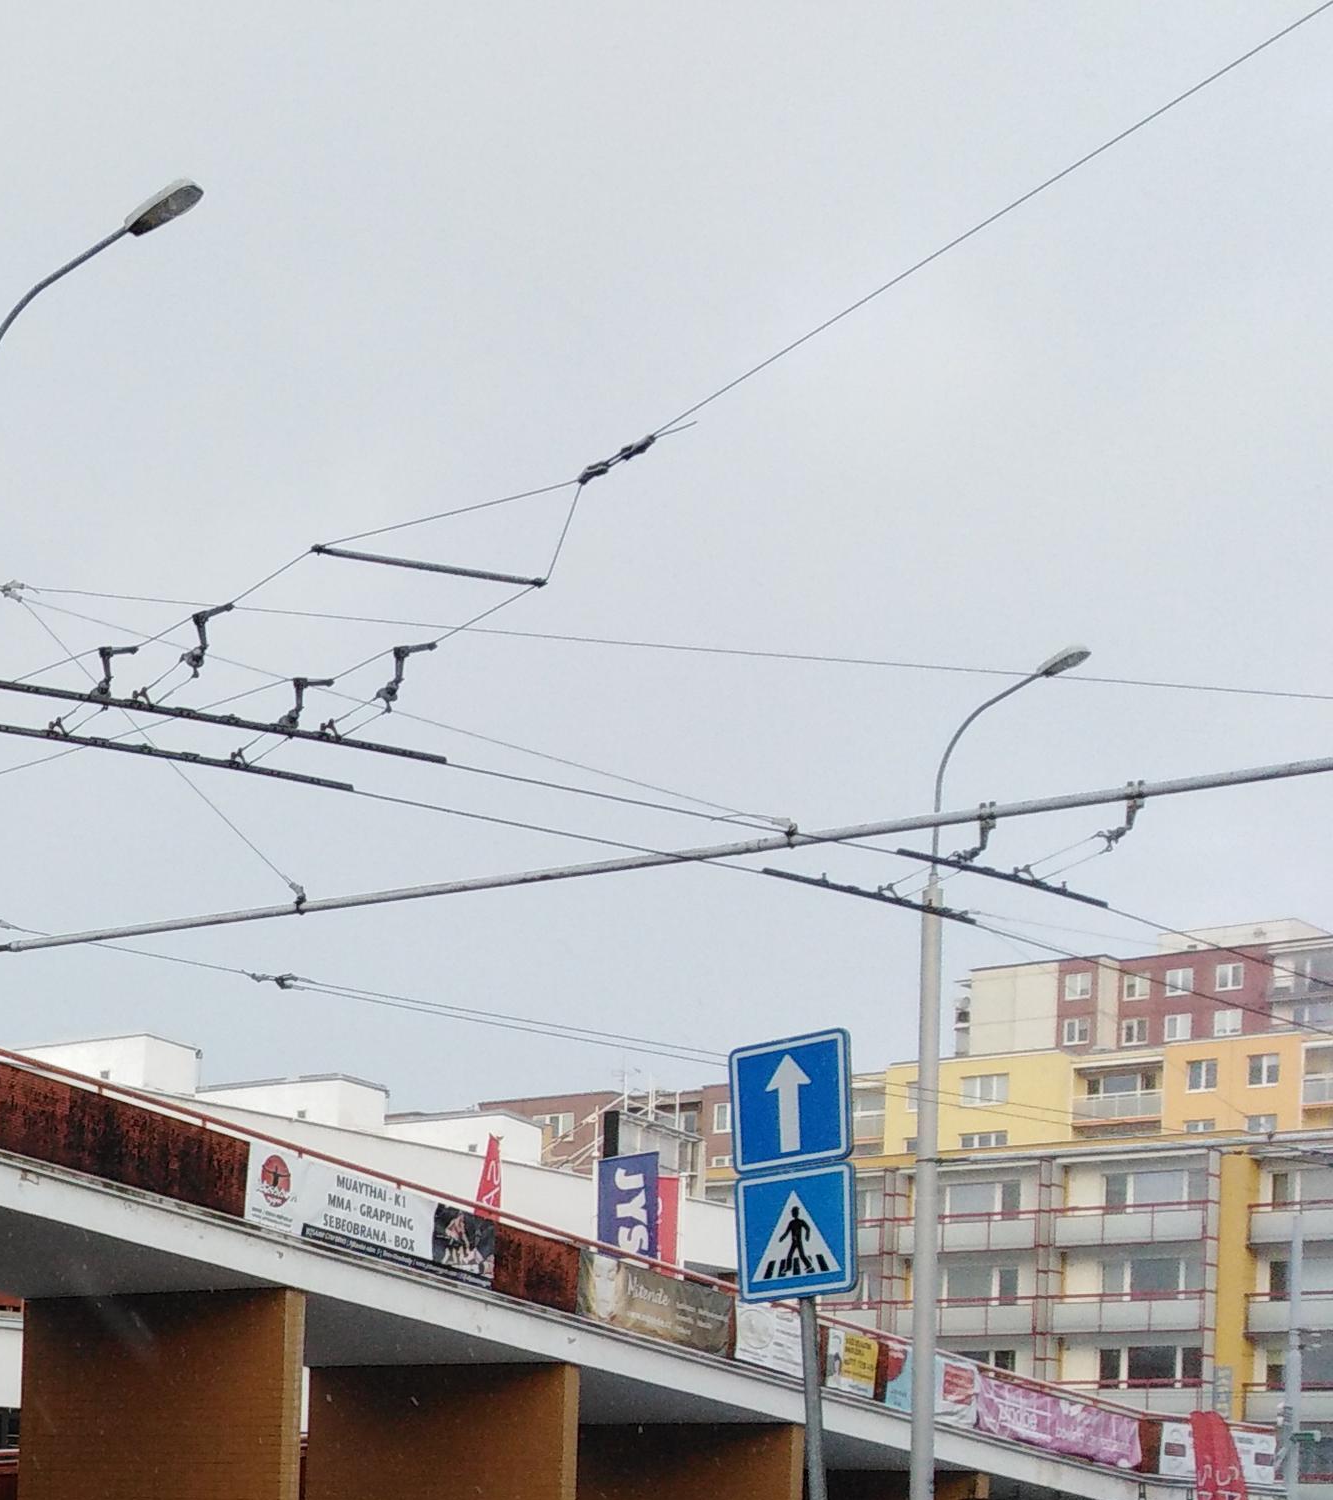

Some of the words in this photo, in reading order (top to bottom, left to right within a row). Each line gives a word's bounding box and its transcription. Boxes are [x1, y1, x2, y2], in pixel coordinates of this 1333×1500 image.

[336, 1174, 387, 1202] MUAYTHAI
[327, 1192, 351, 1212] MMA
[359, 1203, 414, 1231] GRAPPLING
[614, 1167, 650, 1256] JYS
[323, 1213, 387, 1244] SEBEOBRANA
[394, 1234, 415, 1252] BOX
